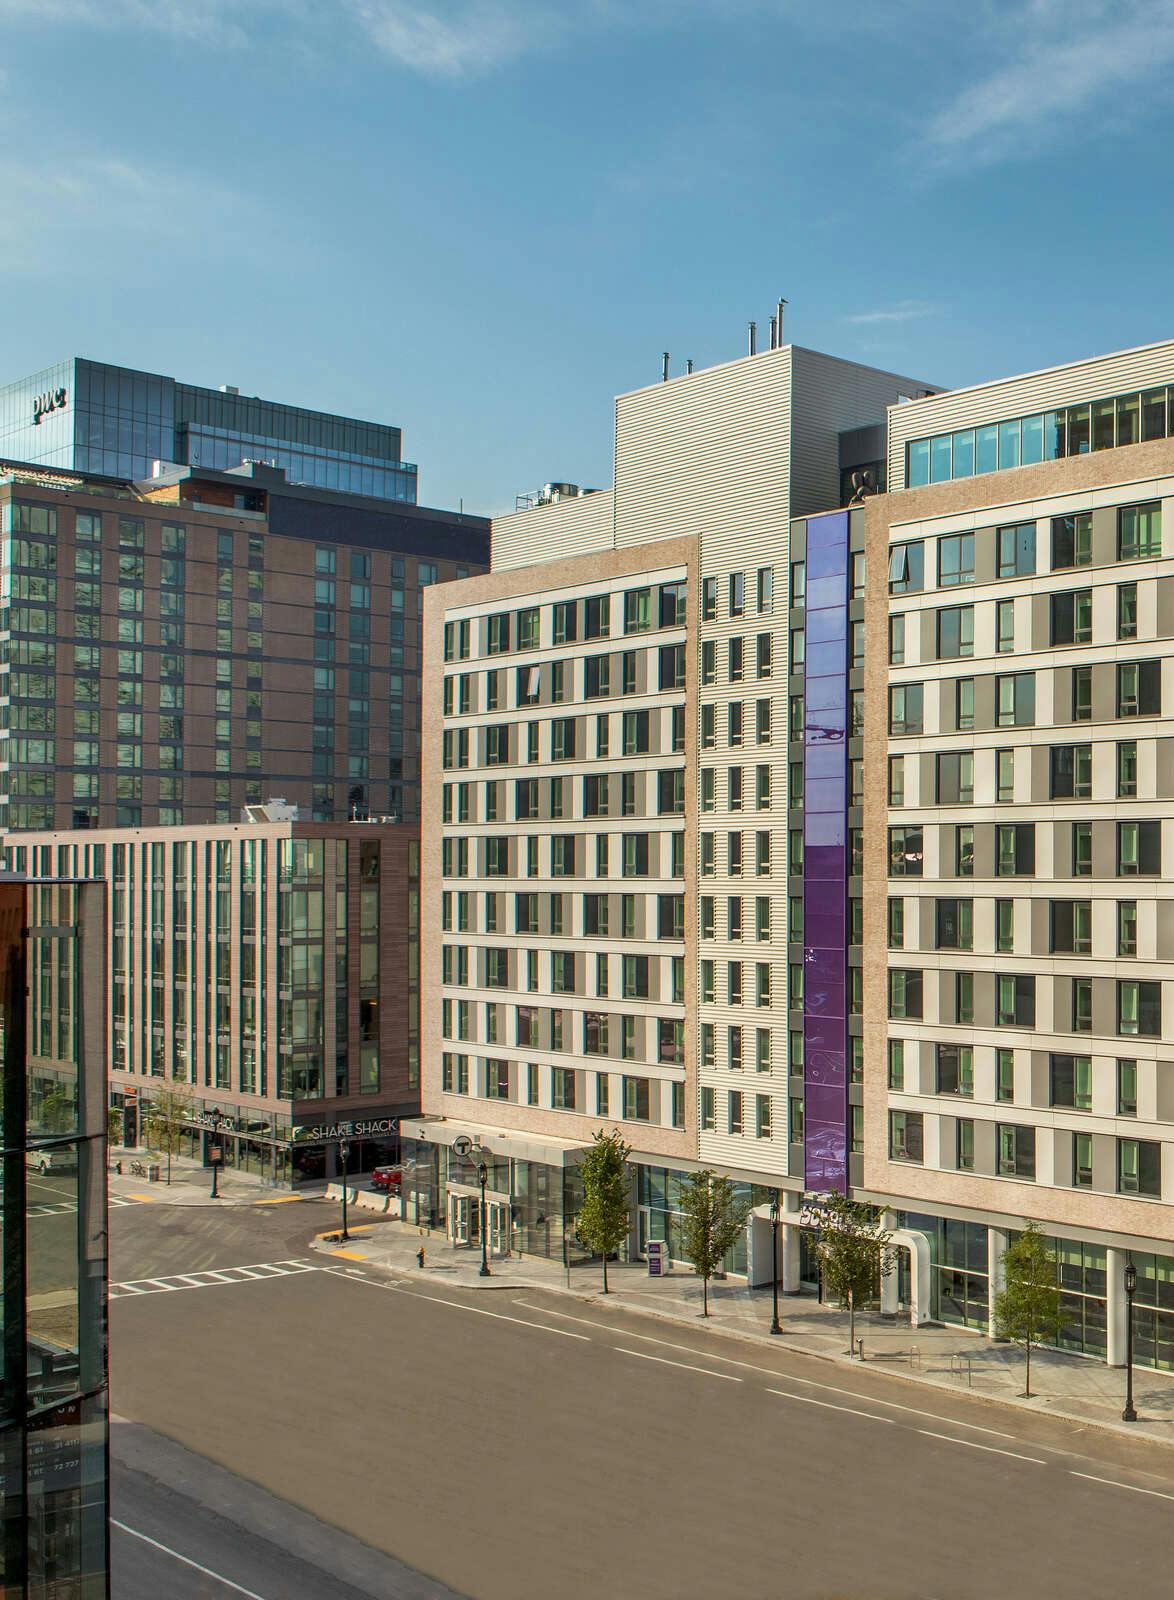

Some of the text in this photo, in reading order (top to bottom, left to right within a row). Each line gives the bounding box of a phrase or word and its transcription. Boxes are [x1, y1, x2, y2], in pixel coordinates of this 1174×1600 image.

[32, 386, 67, 425] pwc
[312, 1123, 353, 1139] SHAKE
[354, 1119, 397, 1135] SHACK
[457, 1141, 470, 1153] T
